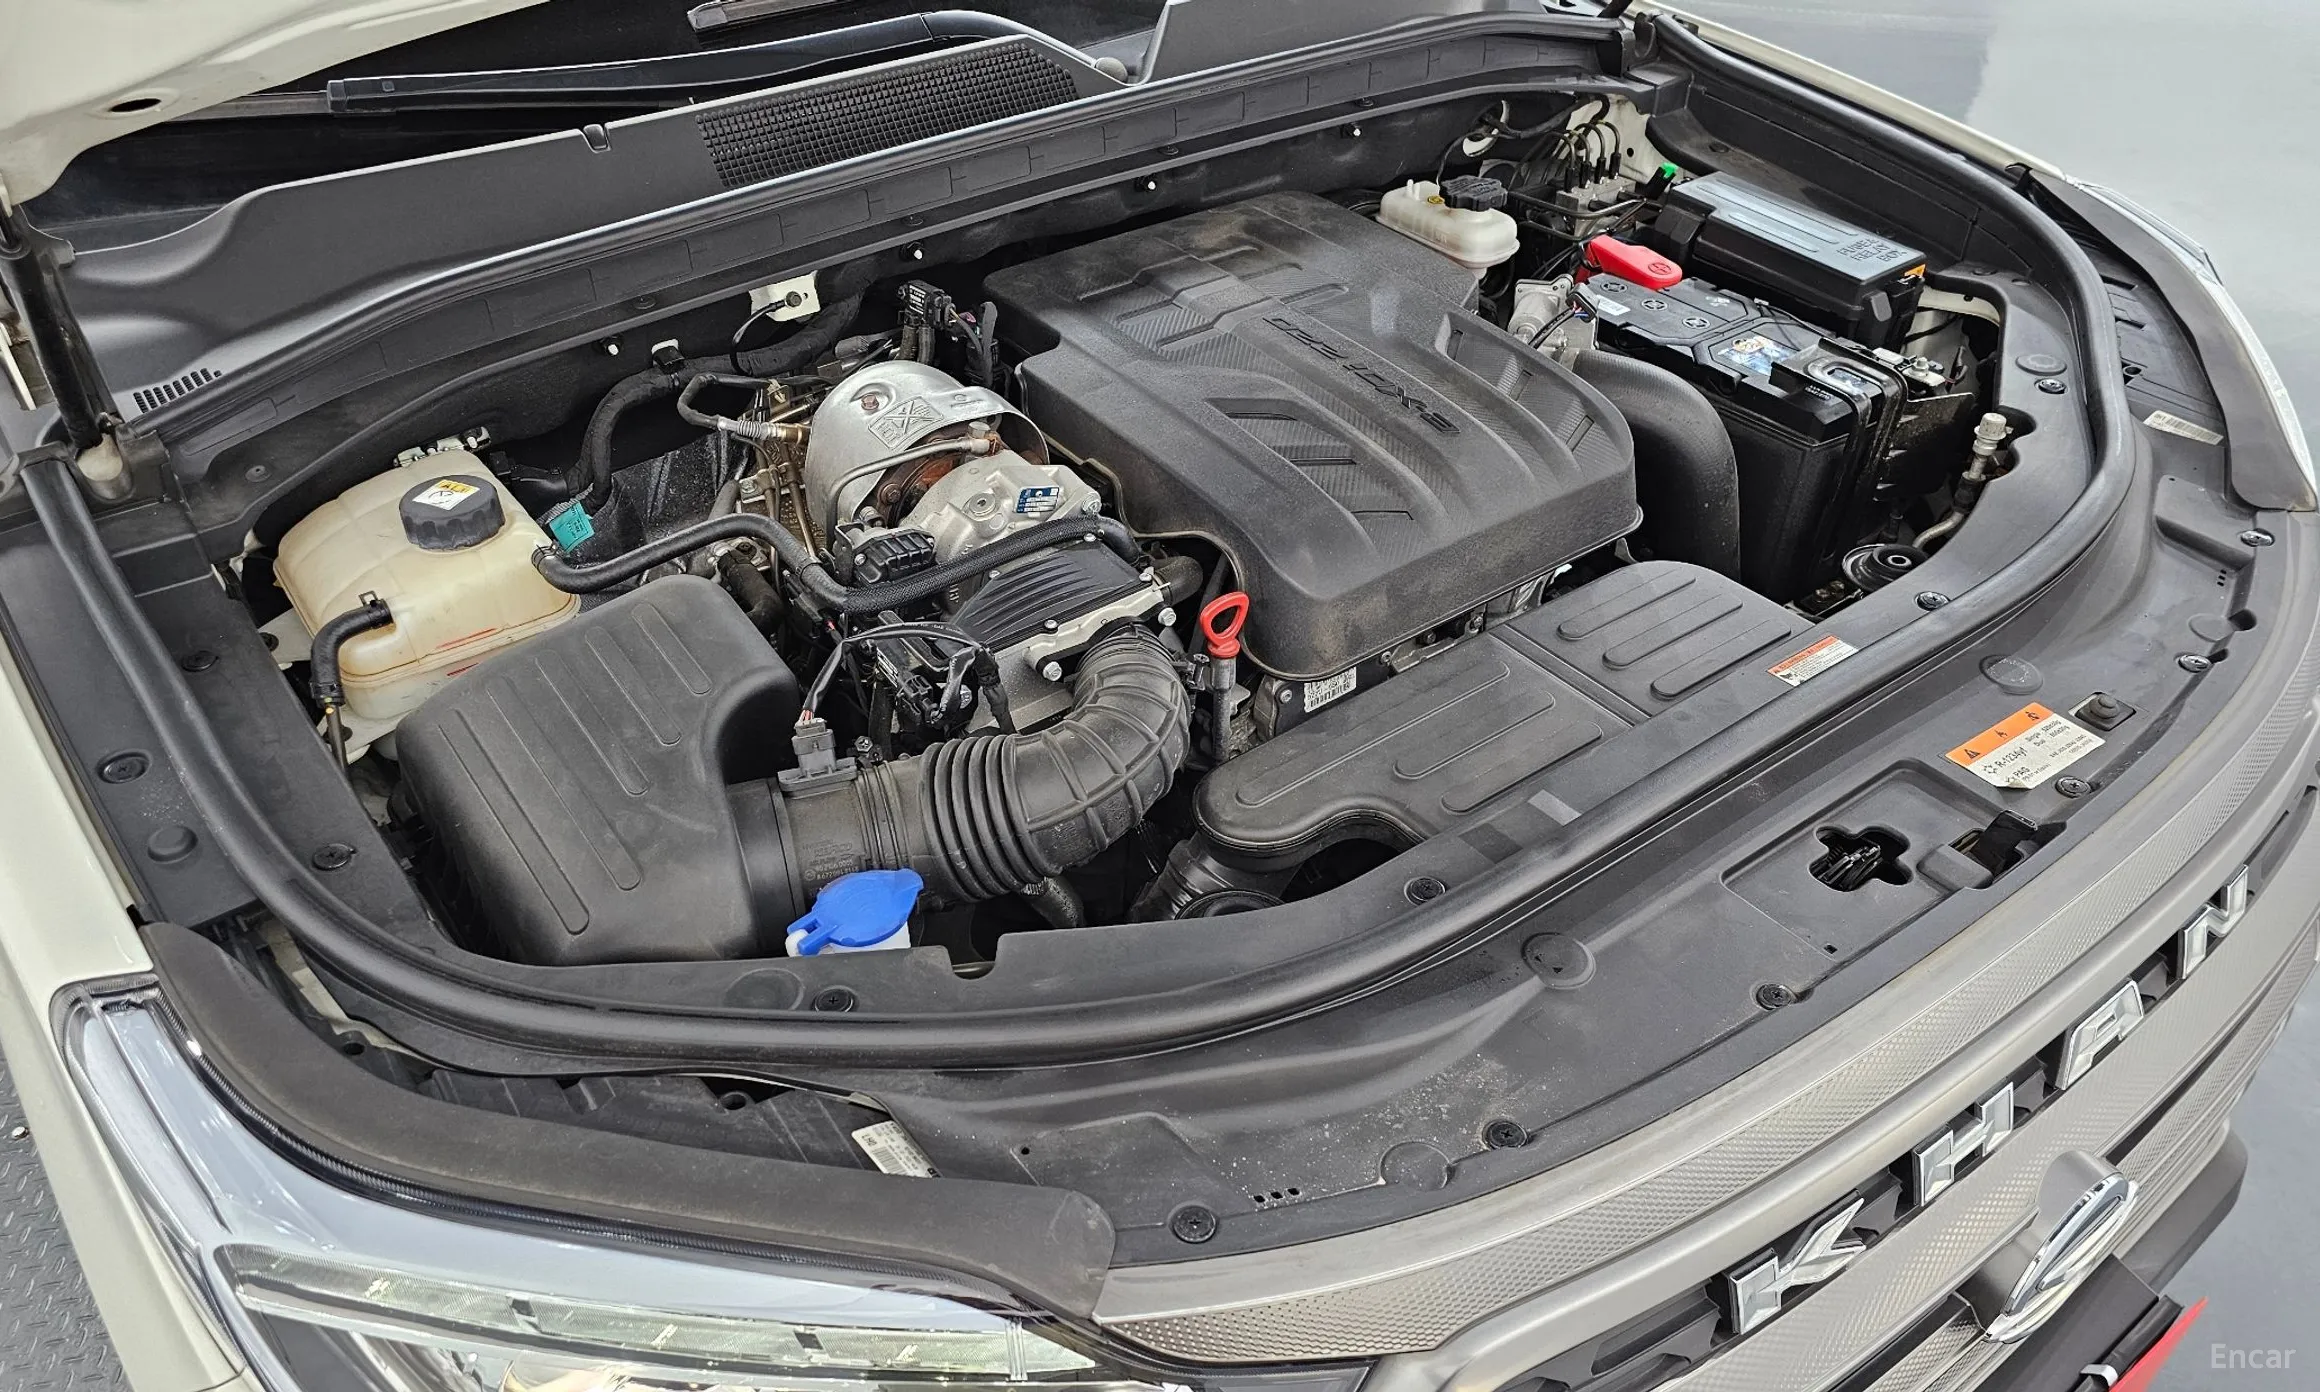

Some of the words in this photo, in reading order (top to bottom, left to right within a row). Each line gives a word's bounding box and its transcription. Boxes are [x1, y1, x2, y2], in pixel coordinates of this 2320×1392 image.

[1994, 745, 2028, 768] R-1234yf
[2012, 766, 2031, 778] PAG
[1728, 863, 2249, 1337] KHAN
